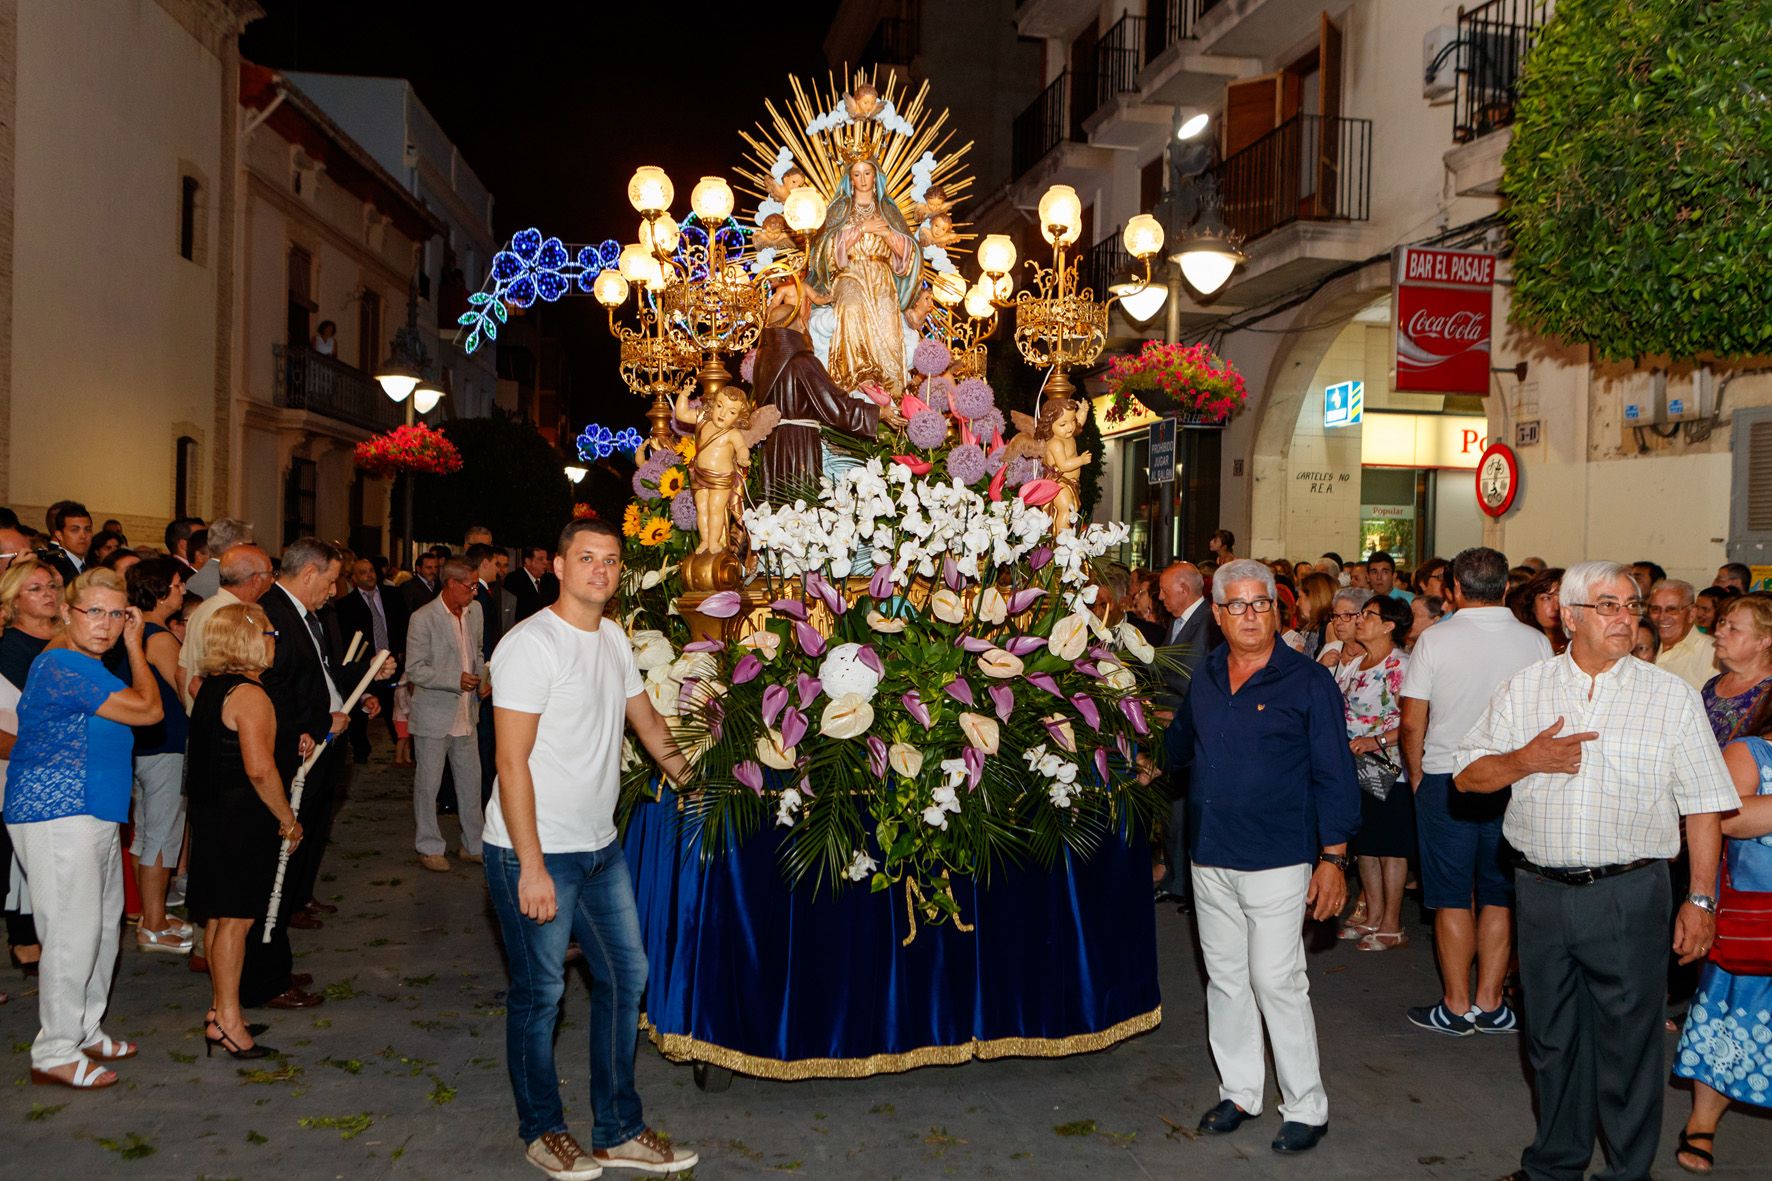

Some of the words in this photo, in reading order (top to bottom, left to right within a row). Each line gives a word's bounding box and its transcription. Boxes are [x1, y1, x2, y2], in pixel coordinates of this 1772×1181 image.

[1409, 252, 1433, 279] BAR
[1434, 254, 1448, 280] EL
[1450, 255, 1491, 283] PASAJE
[1408, 308, 1486, 340] Coca-Cola
[1296, 471, 1334, 481] CARTELES
[1338, 472, 1350, 482] NO
[1372, 506, 1404, 516] Popular
